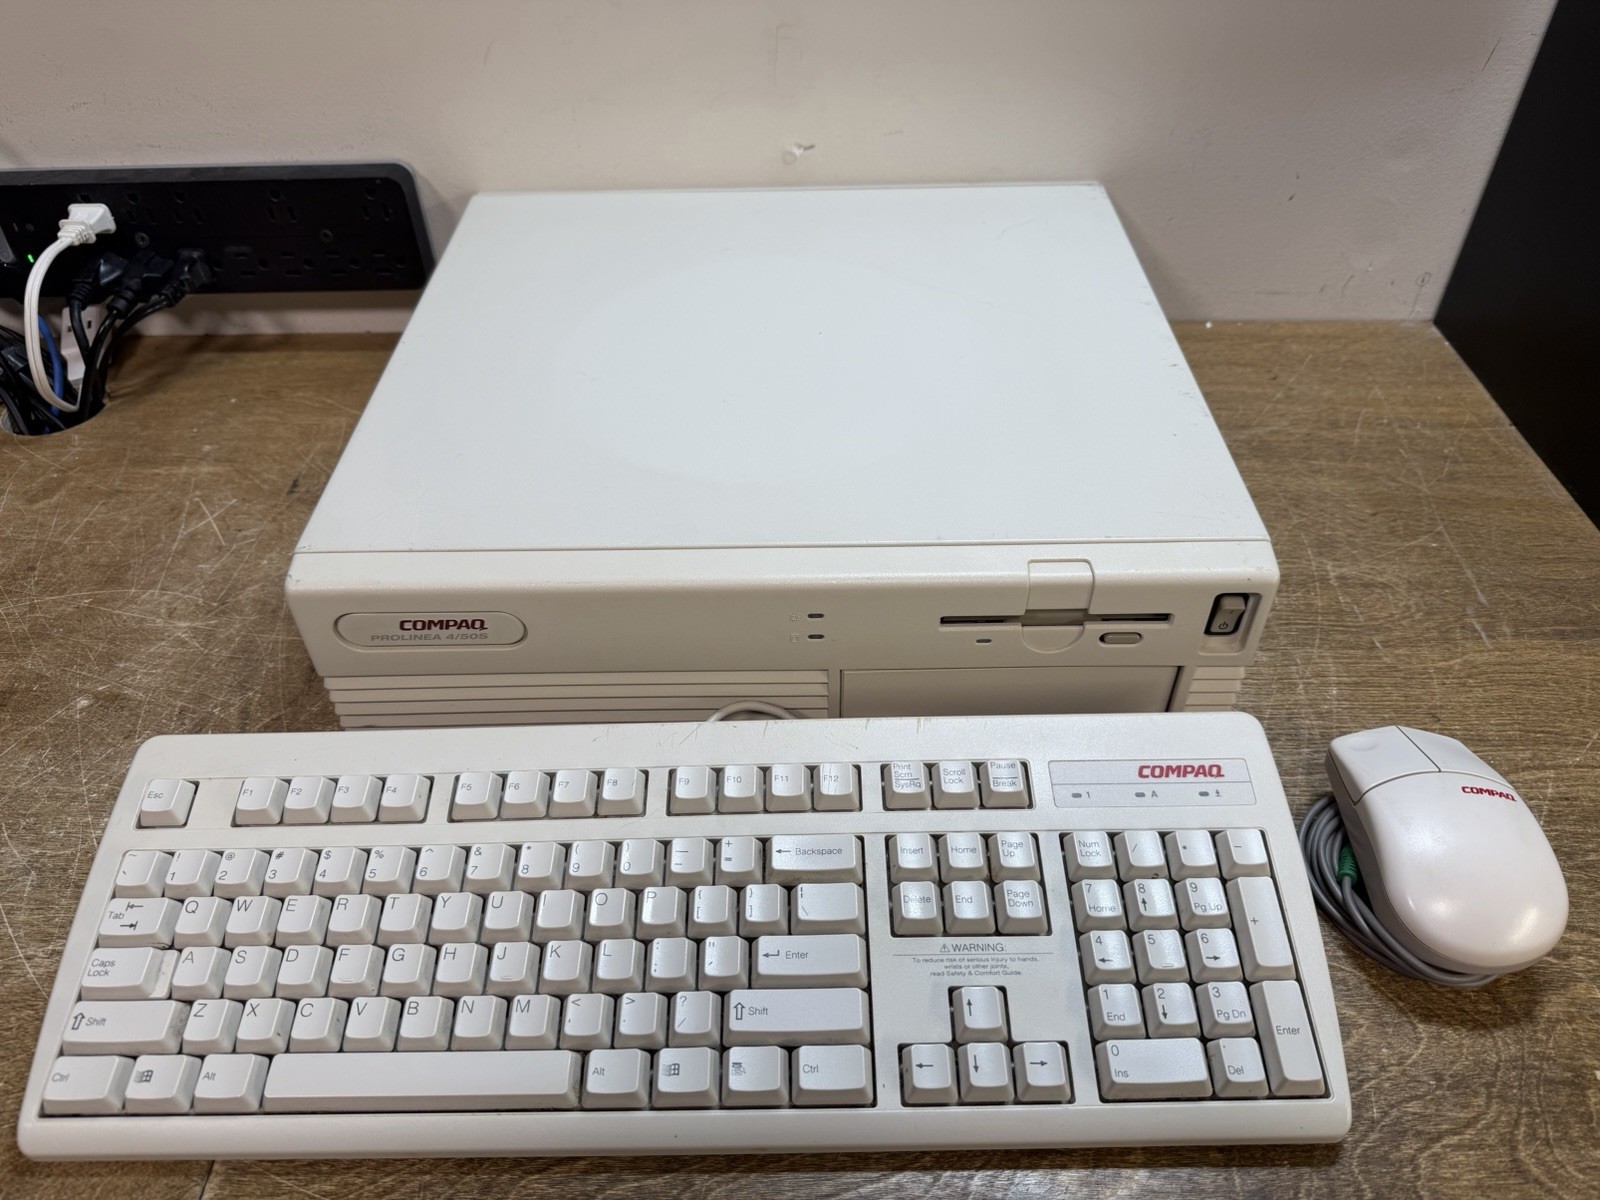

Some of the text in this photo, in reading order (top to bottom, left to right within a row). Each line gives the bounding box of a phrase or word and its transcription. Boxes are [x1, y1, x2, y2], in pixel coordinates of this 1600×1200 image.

[400, 619, 487, 632] COMPAQ
[371, 634, 441, 642] PROLINEA
[943, 768, 965, 776] Scroll
[1138, 764, 1225, 778] COMPAQ
[607, 779, 618, 787] F8
[678, 777, 690, 786] F9
[726, 776, 742, 784] F10
[774, 774, 789, 783] F11
[823, 774, 839, 783] F12
[461, 783, 472, 791] F5
[508, 782, 520, 790] F6
[558, 781, 570, 789] F7
[894, 781, 921, 789] SysRq
[291, 787, 302, 795] F2
[385, 786, 397, 794] F4
[1461, 786, 1517, 802] COMPAQ
[147, 791, 163, 799] Esc
[1001, 840, 1023, 848] Page
[1132, 843, 1137, 853] /
[275, 851, 284, 859] #
[323, 850, 332, 860] $
[374, 850, 384, 858] %
[474, 847, 482, 855] &
[795, 847, 842, 856] Backspace
[1081, 849, 1101, 857] Lock
[225, 852, 236, 860] @
[470, 866, 478, 875] 7
[521, 865, 529, 874] 8
[572, 863, 580, 872] 9
[623, 862, 631, 871] 0
[170, 872, 176, 880] 1
[218, 871, 227, 880] 2
[269, 870, 277, 879] 3
[319, 870, 326, 878] 4
[368, 869, 377, 878] 5
[419, 867, 428, 876] 6
[1085, 884, 1092, 893] 7
[1138, 884, 1146, 893] 8
[1190, 882, 1198, 892] 9
[647, 892, 656, 903] P
[1007, 890, 1029, 898] Page
[389, 897, 400, 909] T
[440, 896, 451, 908] Y
[491, 896, 504, 908] U
[595, 893, 607, 905] O
[185, 901, 199, 914] Q
[236, 900, 253, 911] W
[286, 899, 297, 912] E
[337, 898, 348, 910] R
[1089, 904, 1116, 913] Home
[1194, 903, 1223, 912] Pg Up
[108, 911, 125, 920] Tab
[1250, 917, 1259, 925] +
[1095, 935, 1102, 945] 4
[1148, 935, 1156, 945] 5
[1201, 934, 1209, 944] 6
[444, 948, 457, 960] H
[497, 947, 506, 960] J
[550, 945, 561, 958] K
[603, 943, 611, 956] L
[182, 951, 194, 963] A
[235, 951, 246, 963] S
[286, 950, 299, 962] D
[338, 949, 350, 961] F
[392, 948, 405, 961] G
[785, 951, 808, 959] Enter
[91, 959, 115, 968] Caps
[88, 968, 109, 977] Lock
[1103, 989, 1109, 999] 1
[1157, 988, 1165, 999] 2
[1213, 987, 1221, 997] 3
[680, 996, 687, 1006] ?
[193, 1004, 207, 1017] Z
[247, 1003, 260, 1017] X
[300, 1003, 314, 1017] C
[356, 1003, 367, 1015] V
[407, 1002, 419, 1015] B
[461, 1001, 474, 1013] N
[515, 1000, 530, 1013] M
[749, 1007, 768, 1015] Shift
[1107, 1012, 1125, 1021] End
[1217, 1009, 1246, 1020] Pg Dn
[86, 1017, 106, 1026] Shift
[677, 1018, 686, 1028] /
[1276, 1025, 1300, 1035] Enter
[1111, 1045, 1119, 1056] 0
[592, 1067, 605, 1076] Alt
[803, 1065, 819, 1074] Ctrl
[1114, 1069, 1129, 1078] Ins
[1228, 1065, 1244, 1074] Del
[52, 1073, 70, 1082] Ctrl
[203, 1072, 216, 1081] Alt
